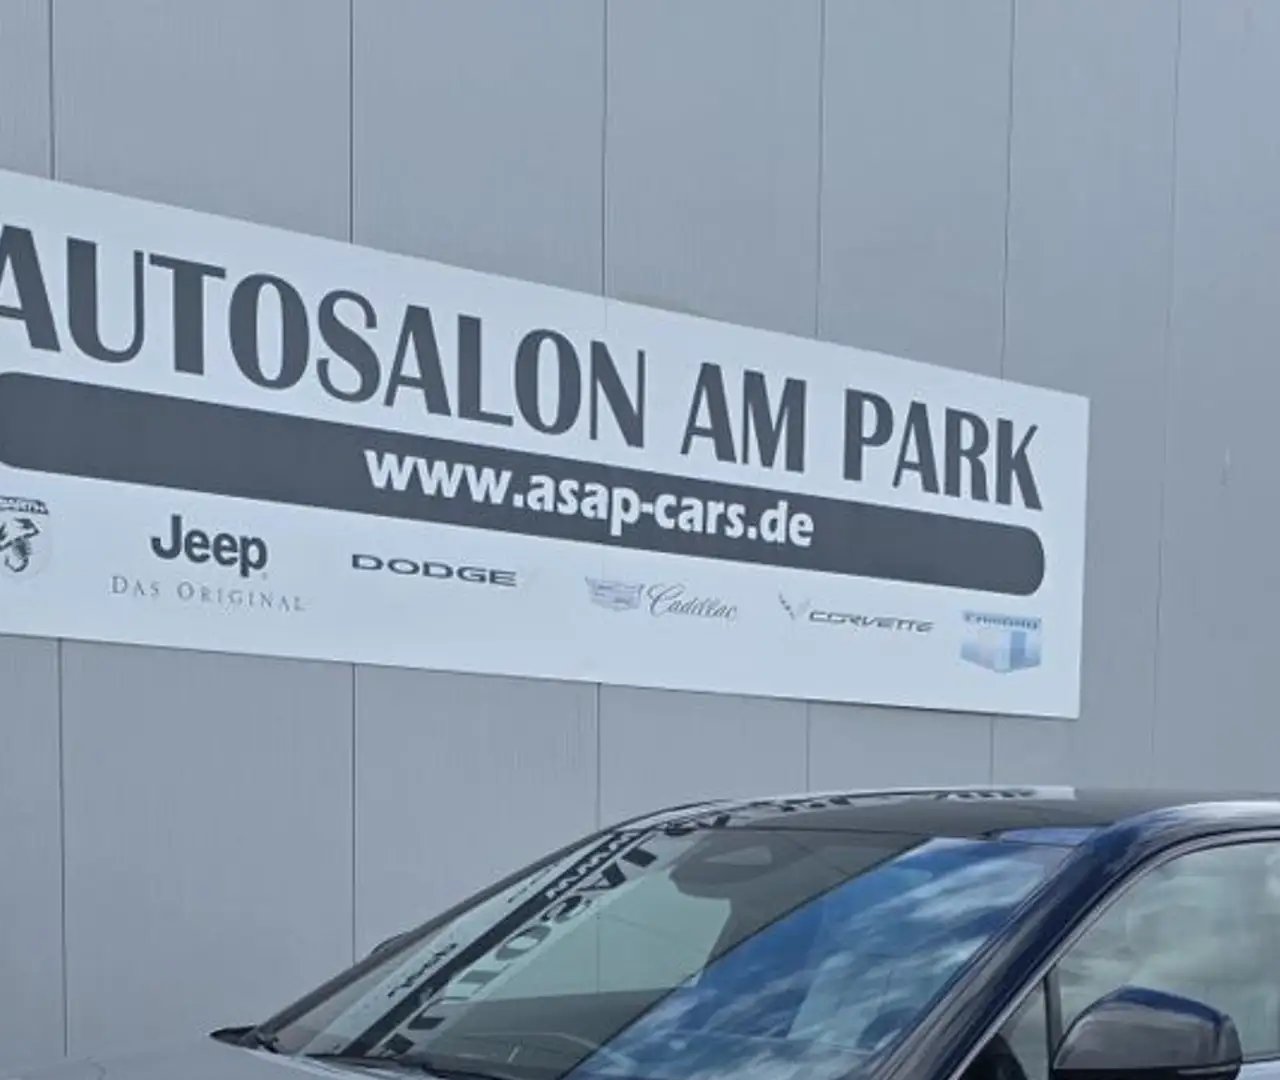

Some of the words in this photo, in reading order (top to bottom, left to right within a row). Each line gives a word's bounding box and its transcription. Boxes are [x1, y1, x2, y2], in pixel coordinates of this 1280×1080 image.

[681, 362, 807, 473] AM
[842, 388, 1043, 510] PARK
[363, 449, 815, 547] www.asap-cars.de
[150, 513, 268, 578] Jeep
[351, 553, 518, 587] DODGE
[111, 575, 160, 598] DAS
[176, 581, 307, 612] ORIGINAL
[646, 582, 738, 623] Cadillac
[809, 610, 935, 633] CORVETTE
